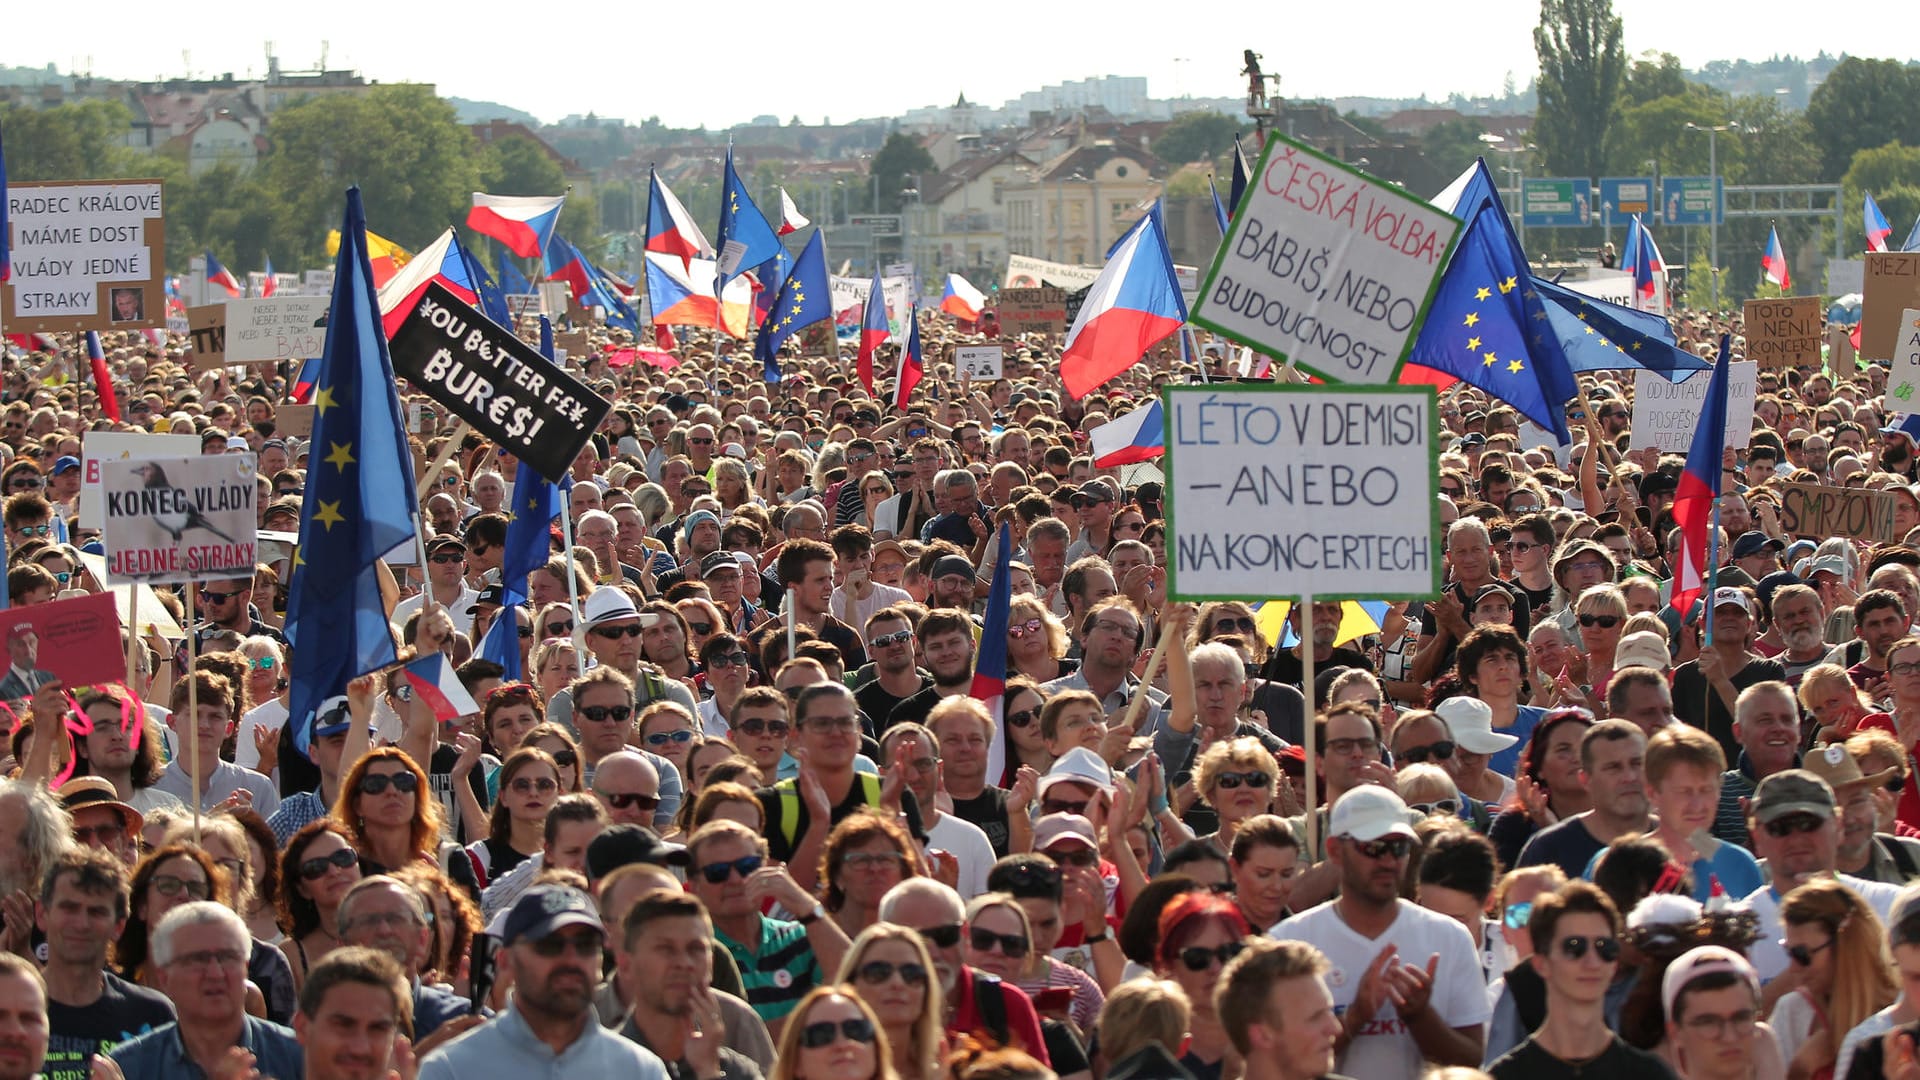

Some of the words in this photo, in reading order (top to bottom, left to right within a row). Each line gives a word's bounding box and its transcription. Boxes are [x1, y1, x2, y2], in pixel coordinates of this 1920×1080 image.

[10, 198, 70, 214] RADEC
[79, 191, 160, 212] KRÁLOVÉ
[1264, 147, 1367, 229] ČESKÁ
[1363, 197, 1446, 266] VOLBA:
[22, 225, 82, 245] MÁME
[90, 226, 139, 243] DOST
[14, 257, 73, 277] VLÁDY
[83, 254, 139, 275] JEDNÉ
[23, 292, 91, 309] STRAKY
[1334, 269, 1417, 332] NEBO
[1750, 304, 1793, 321] TOTO
[1213, 275, 1387, 377] BUDOUCNOST
[276, 334, 323, 357] BABI
[1749, 337, 1819, 355] KONCERT
[1177, 394, 1281, 445] LÉTO
[1290, 403, 1310, 446] V
[1323, 403, 1422, 446] DEMISI
[108, 488, 187, 517] KONEC
[195, 480, 253, 512] VLÁDY
[1782, 487, 1893, 543] SMRŽOVKA
[111, 545, 180, 574] JEDNÉ
[187, 543, 254, 570] STRAKY
